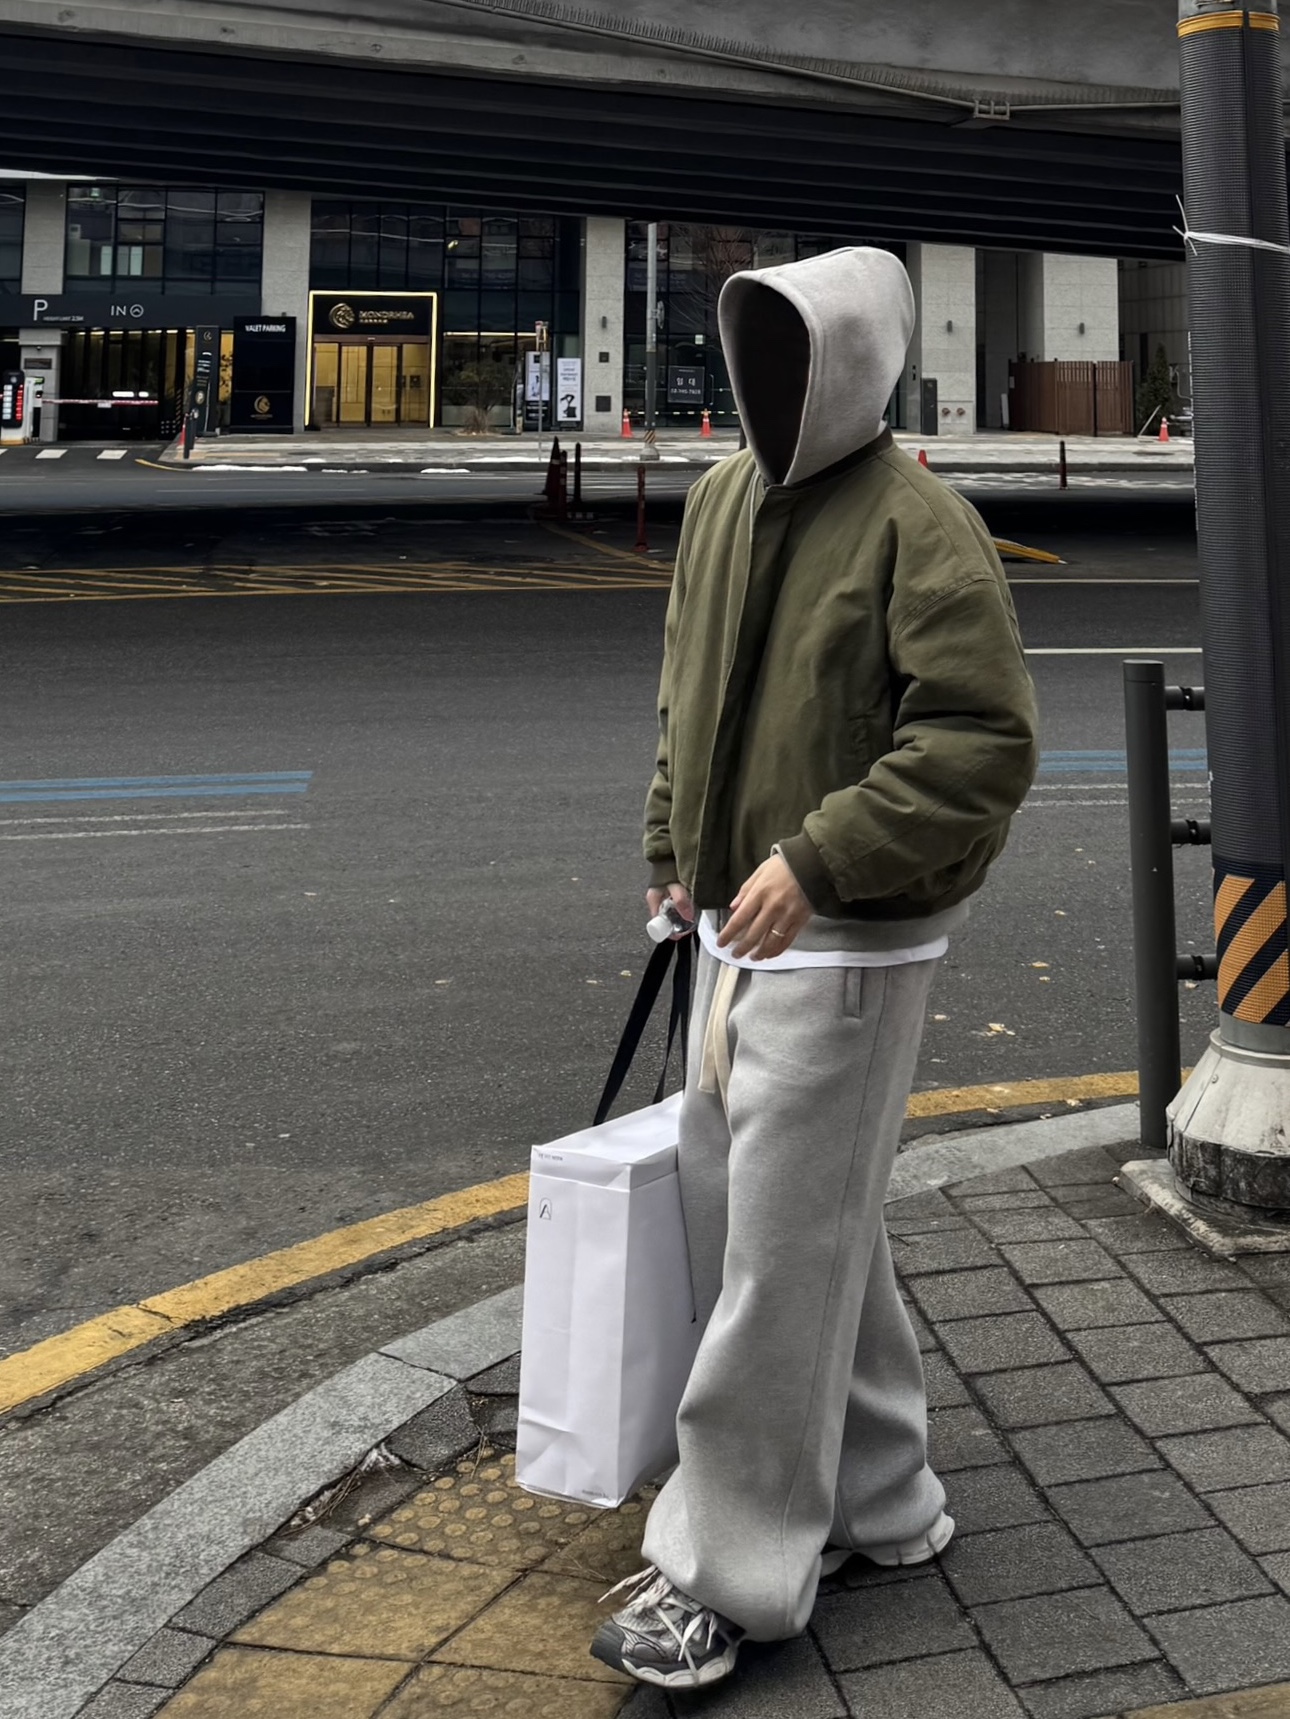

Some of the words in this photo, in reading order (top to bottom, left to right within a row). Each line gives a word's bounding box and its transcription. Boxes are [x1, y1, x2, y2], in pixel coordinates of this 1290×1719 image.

[33, 299, 49, 321] P
[110, 305, 127, 316] IN
[245, 324, 262, 332] VALET
[262, 324, 286, 333] PARKING
